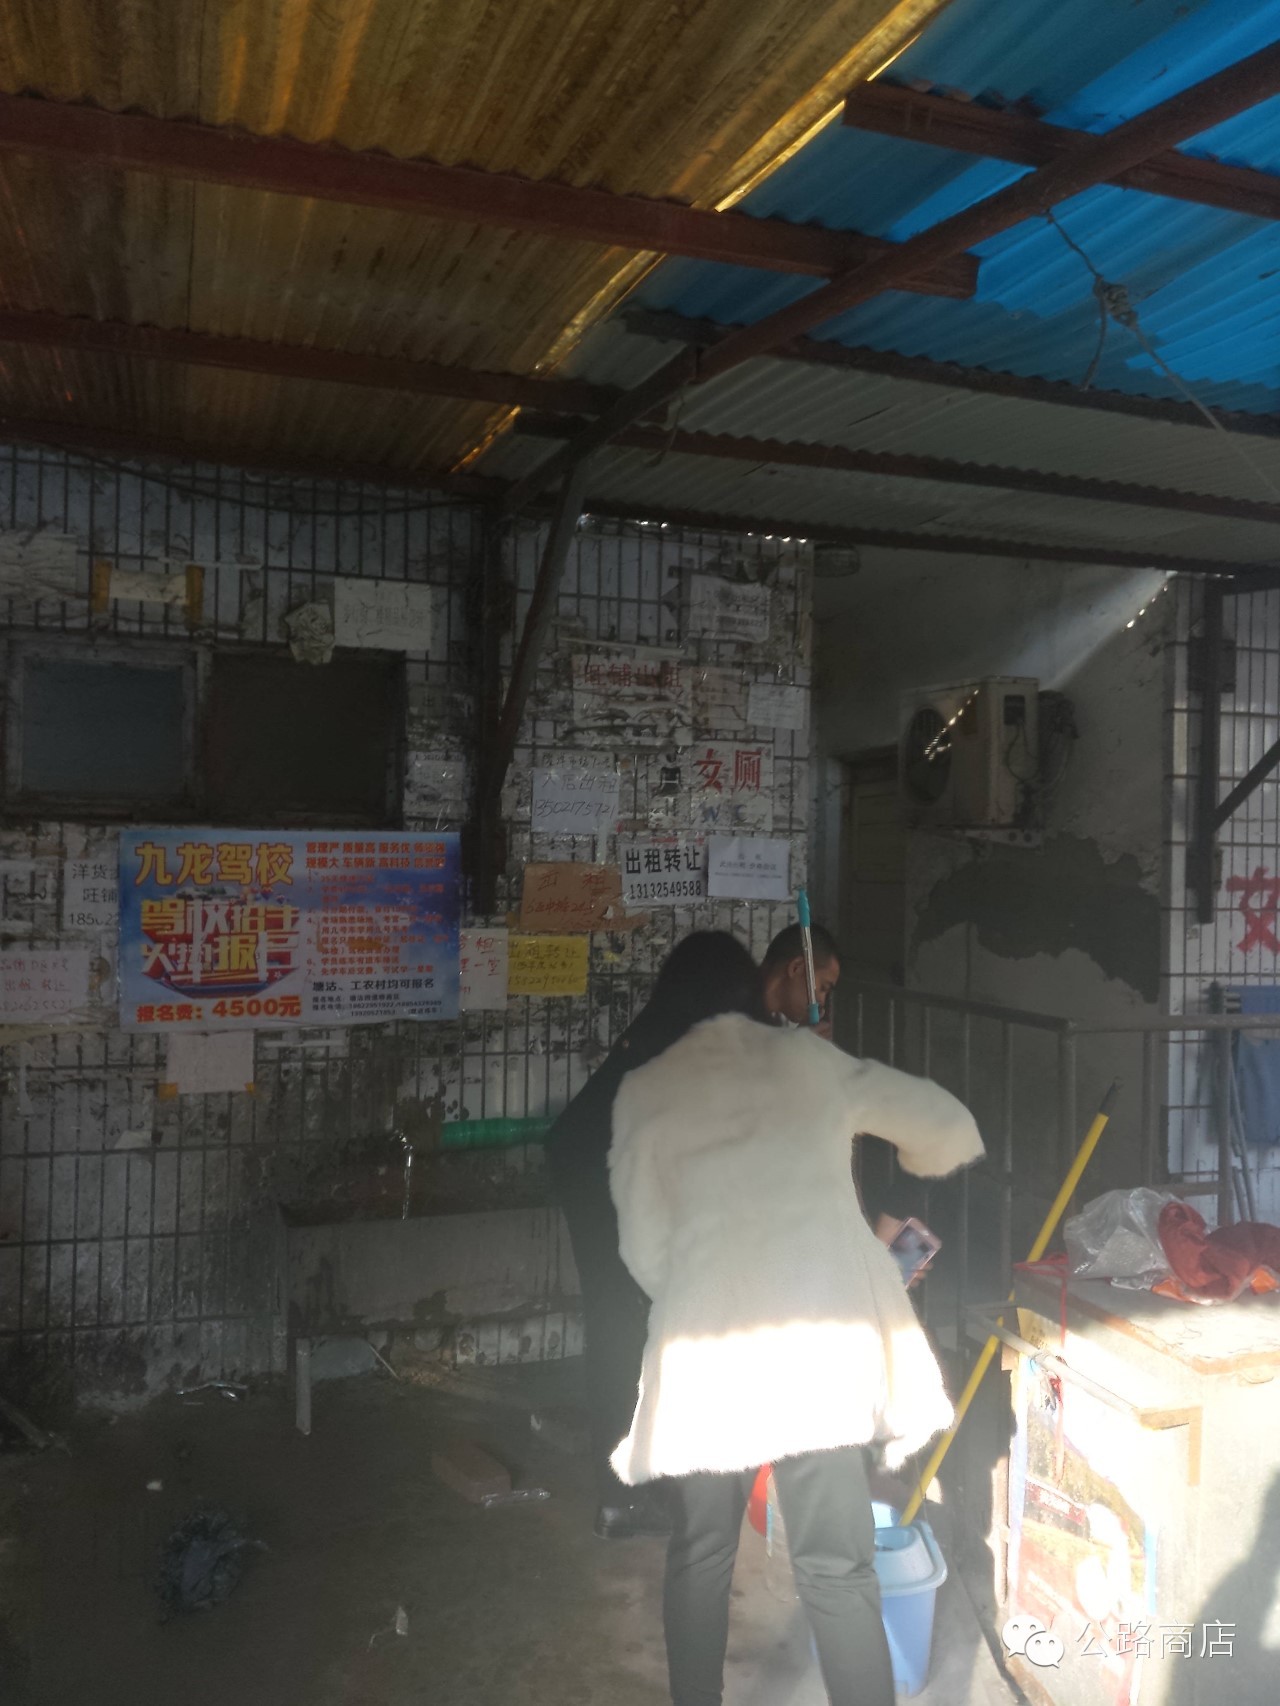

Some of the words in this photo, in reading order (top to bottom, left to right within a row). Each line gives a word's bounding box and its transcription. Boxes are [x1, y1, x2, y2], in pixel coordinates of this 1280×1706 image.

[694, 748, 762, 793] 女厕
[135, 841, 293, 886] 九龙驾校
[625, 847, 702, 874] 出租转让
[629, 881, 703, 901] 13132549588
[1225, 866, 1280, 956] 女
[313, 978, 434, 993] 塘沽、工农村均可报名
